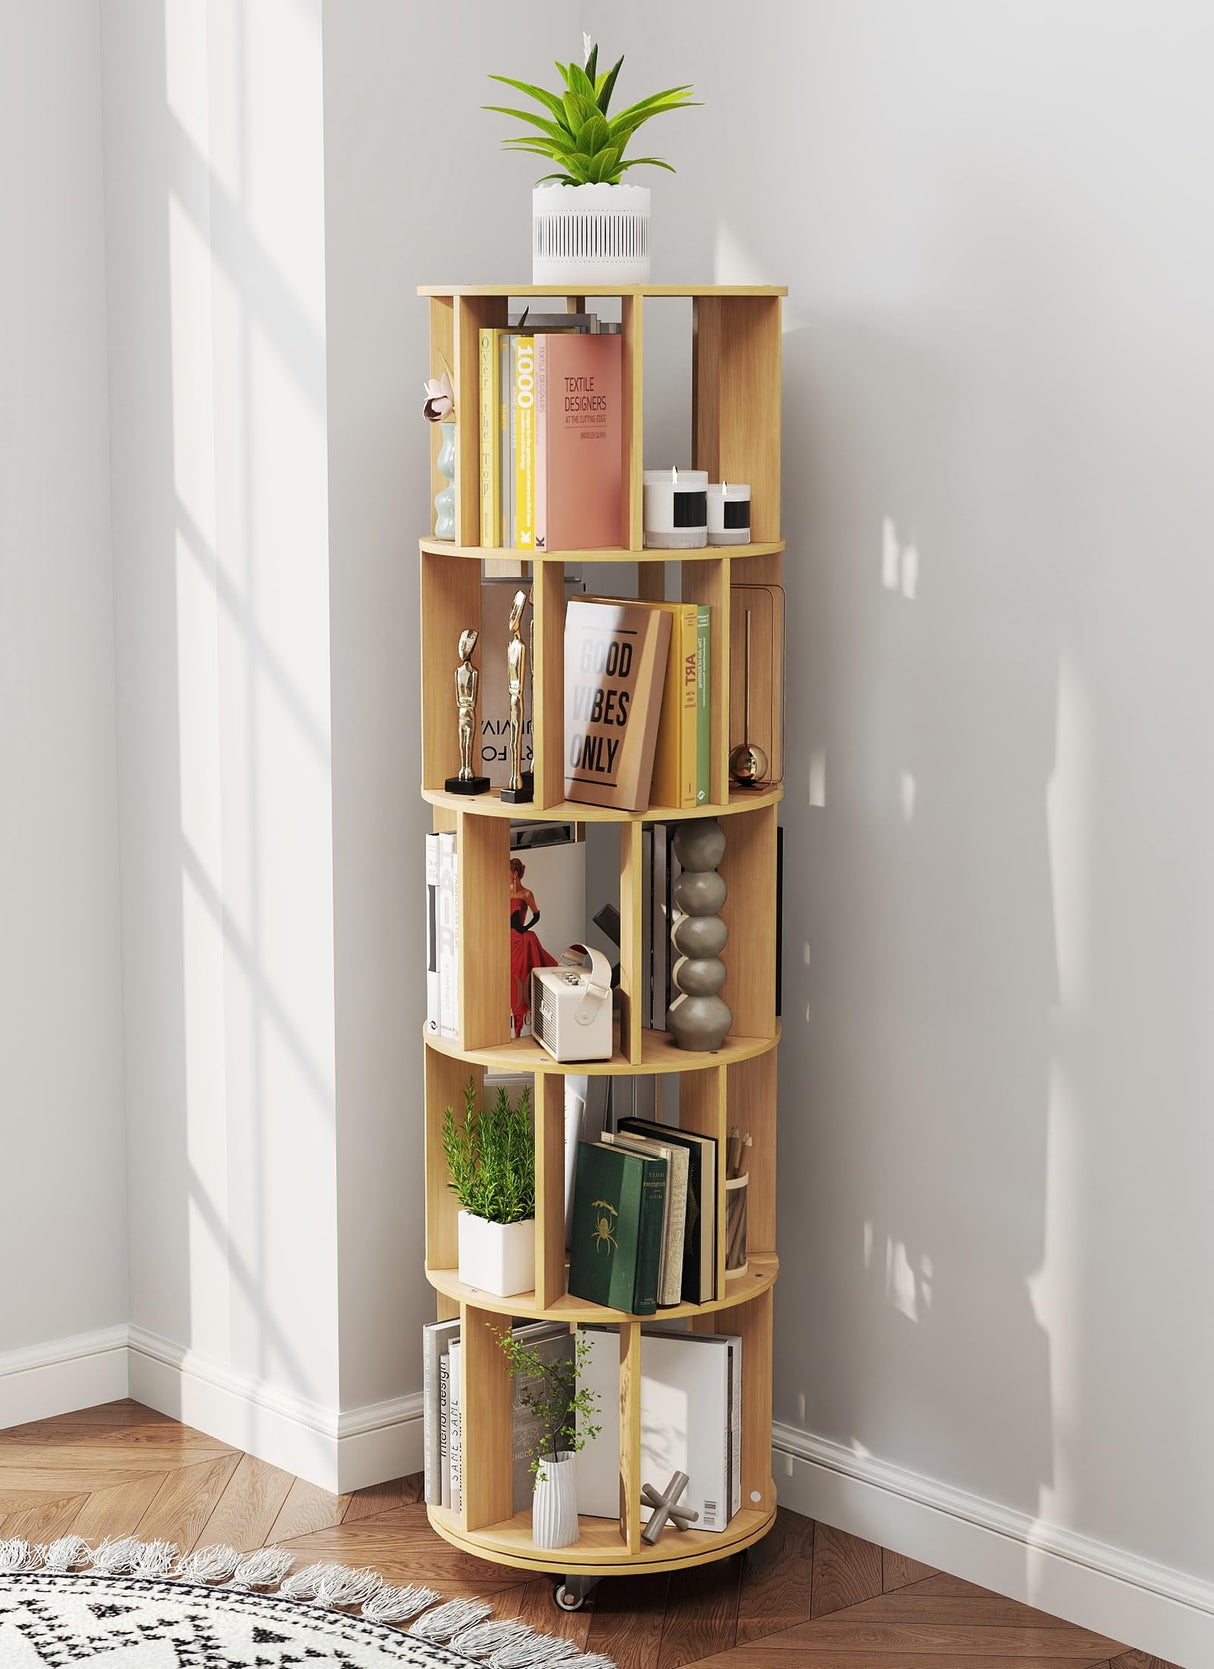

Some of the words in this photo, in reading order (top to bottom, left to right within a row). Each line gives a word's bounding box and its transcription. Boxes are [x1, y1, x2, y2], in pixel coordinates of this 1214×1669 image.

[517, 345, 534, 409] 1000
[564, 377, 594, 392] TEXTILE
[564, 396, 607, 412] DESIGNERS
[535, 536, 545, 547] K
[581, 638, 633, 678] GOOD
[573, 685, 630, 727] VIBES
[569, 733, 620, 774] ONLY
[440, 1361, 449, 1407] design
